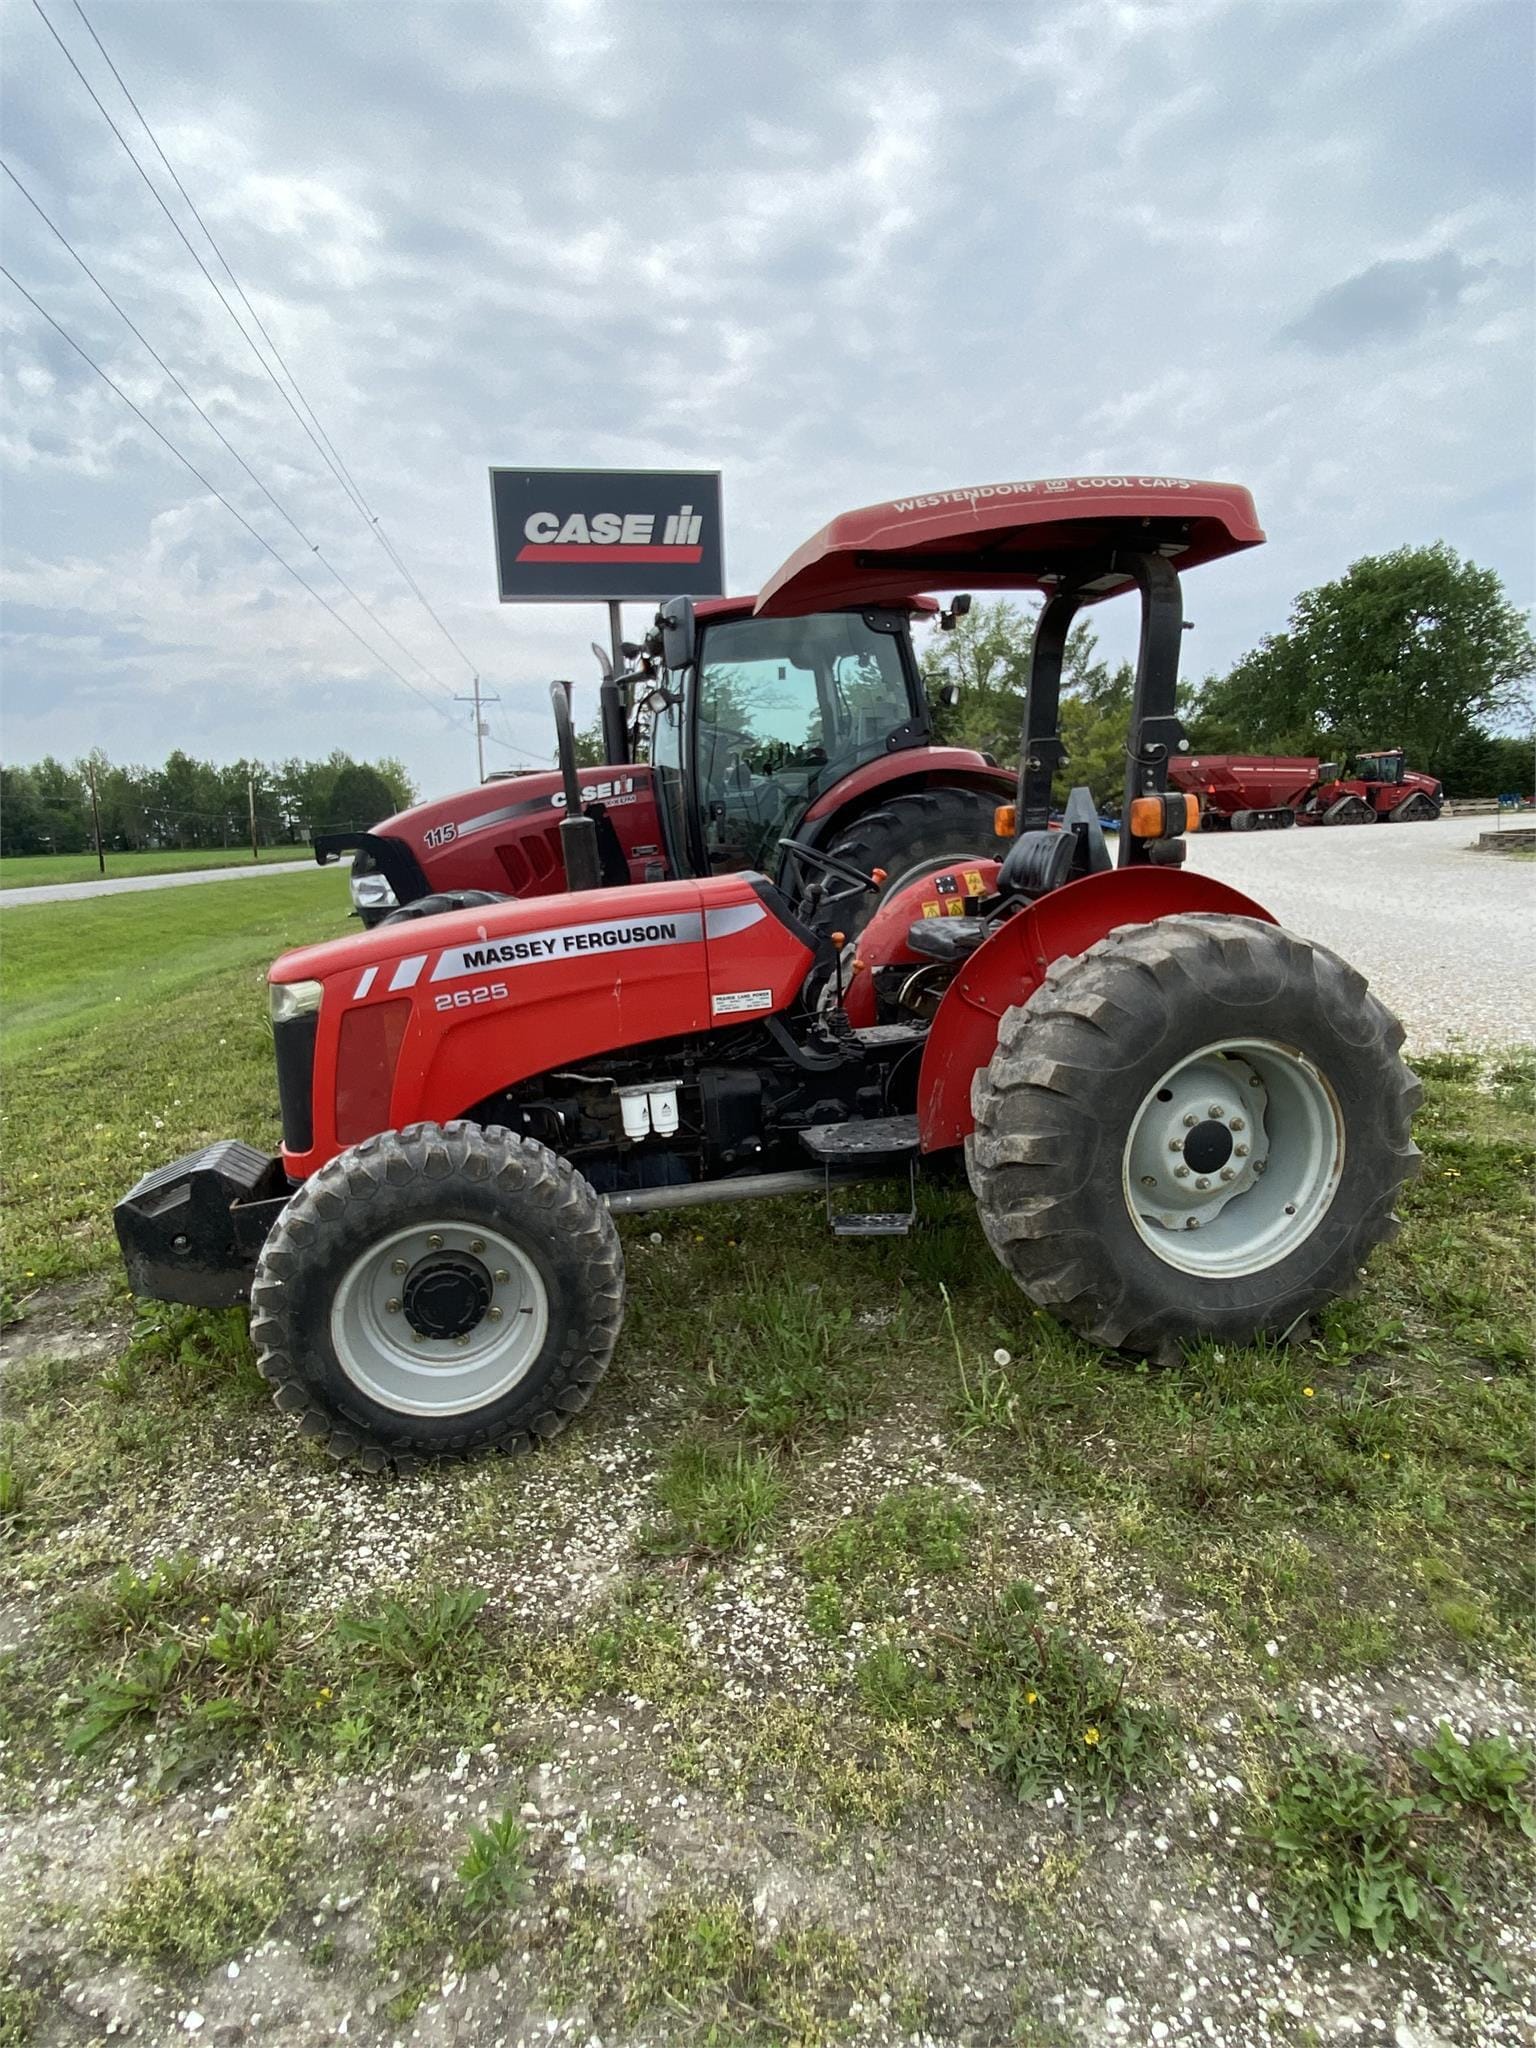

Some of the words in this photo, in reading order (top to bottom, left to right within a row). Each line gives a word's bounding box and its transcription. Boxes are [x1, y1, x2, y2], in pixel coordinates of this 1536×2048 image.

[894, 483, 1037, 513] WESTENDORF
[1077, 477, 1133, 488] COOL
[1139, 478, 1190, 490] CAPS
[524, 512, 656, 545] CASE
[551, 782, 612, 808] CSE
[423, 822, 457, 850] 115
[463, 938, 557, 969] MASSEY
[563, 923, 677, 951] FERGUSON
[435, 983, 509, 1012] 2625
